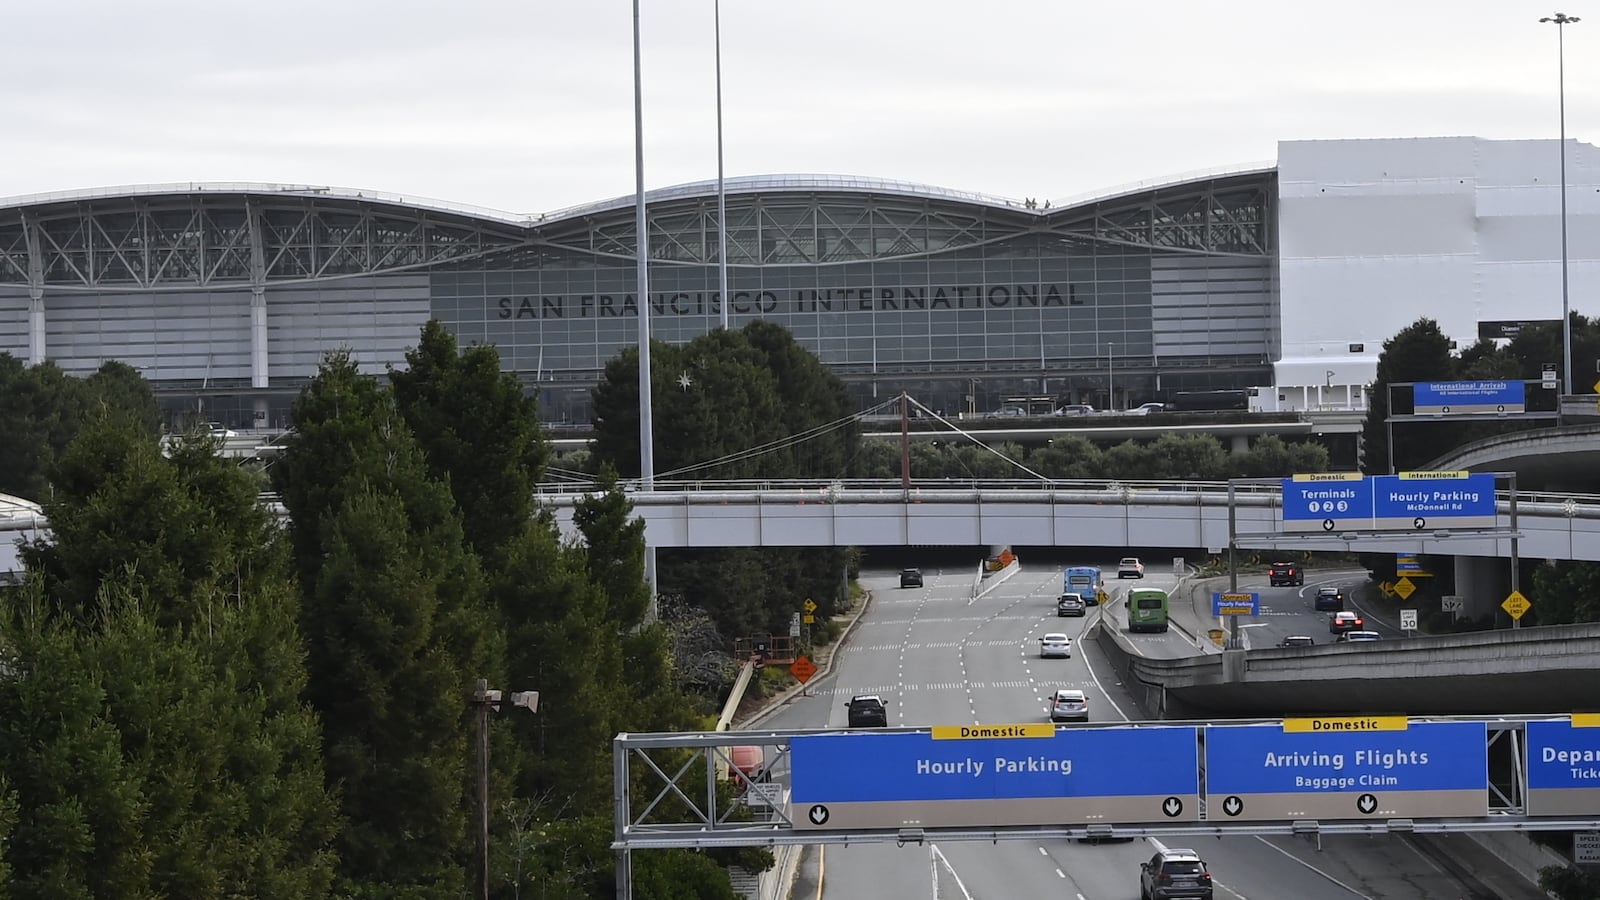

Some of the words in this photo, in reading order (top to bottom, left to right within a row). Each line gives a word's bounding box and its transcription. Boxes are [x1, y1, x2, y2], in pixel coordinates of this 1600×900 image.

[498, 296, 563, 319] SAN
[581, 290, 777, 317] FRANCISCO
[797, 283, 1084, 312] INTERNATIONAL
[1430, 383, 1476, 391] International
[1480, 382, 1507, 390] Arrivals
[1310, 473, 1345, 481] Domestic
[1408, 471, 1459, 479] International
[1301, 488, 1356, 499] Terminals
[1389, 492, 1430, 503] Hourly
[1434, 491, 1479, 502] Parking
[1407, 503, 1450, 511] McDonnell
[1403, 620, 1416, 628] 30
[1313, 719, 1378, 730] Domestic
[961, 726, 1026, 737] Domestic
[1264, 751, 1344, 770] Arriving
[1355, 749, 1429, 769] Flights
[917, 758, 984, 777] Hourly
[995, 756, 1072, 775] Parking
[1295, 776, 1355, 789] Baggage
[1359, 775, 1398, 786] Claim
